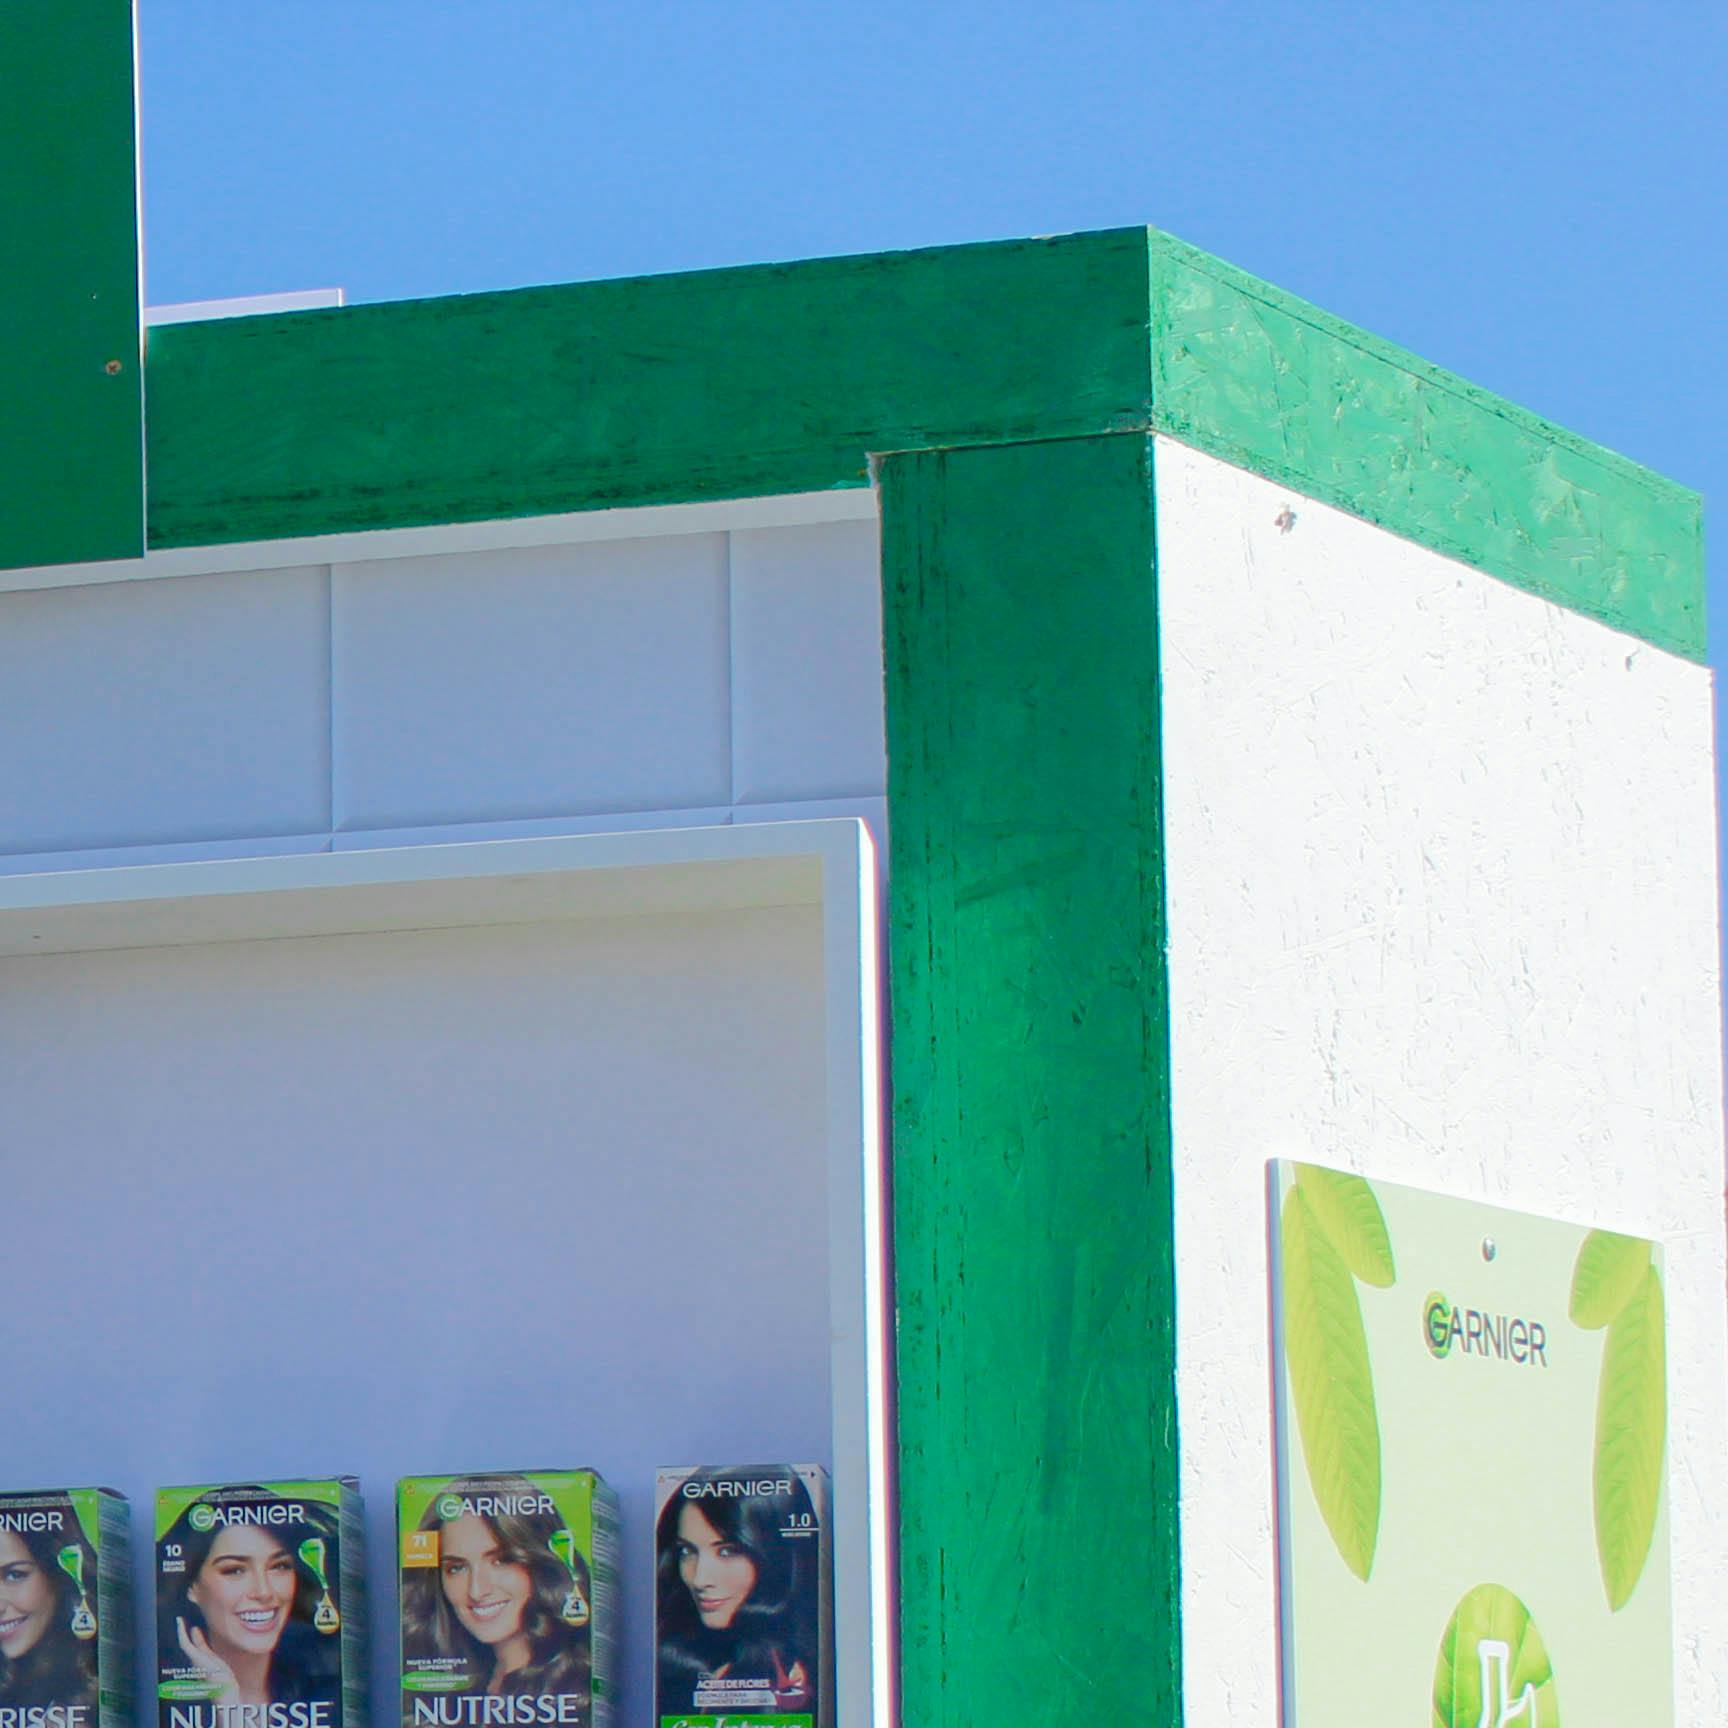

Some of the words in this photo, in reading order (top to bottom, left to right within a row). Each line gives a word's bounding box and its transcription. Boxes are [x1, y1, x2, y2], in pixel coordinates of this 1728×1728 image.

[1427, 1302, 1548, 1368] GARNIER
[682, 1480, 792, 1498] GARNIER
[192, 1504, 305, 1527] GARNIER
[440, 1495, 555, 1518] GARNIER
[788, 1513, 811, 1528] 1.0
[165, 1544, 182, 1557] 10
[414, 1693, 579, 1726] NUTRISSE
